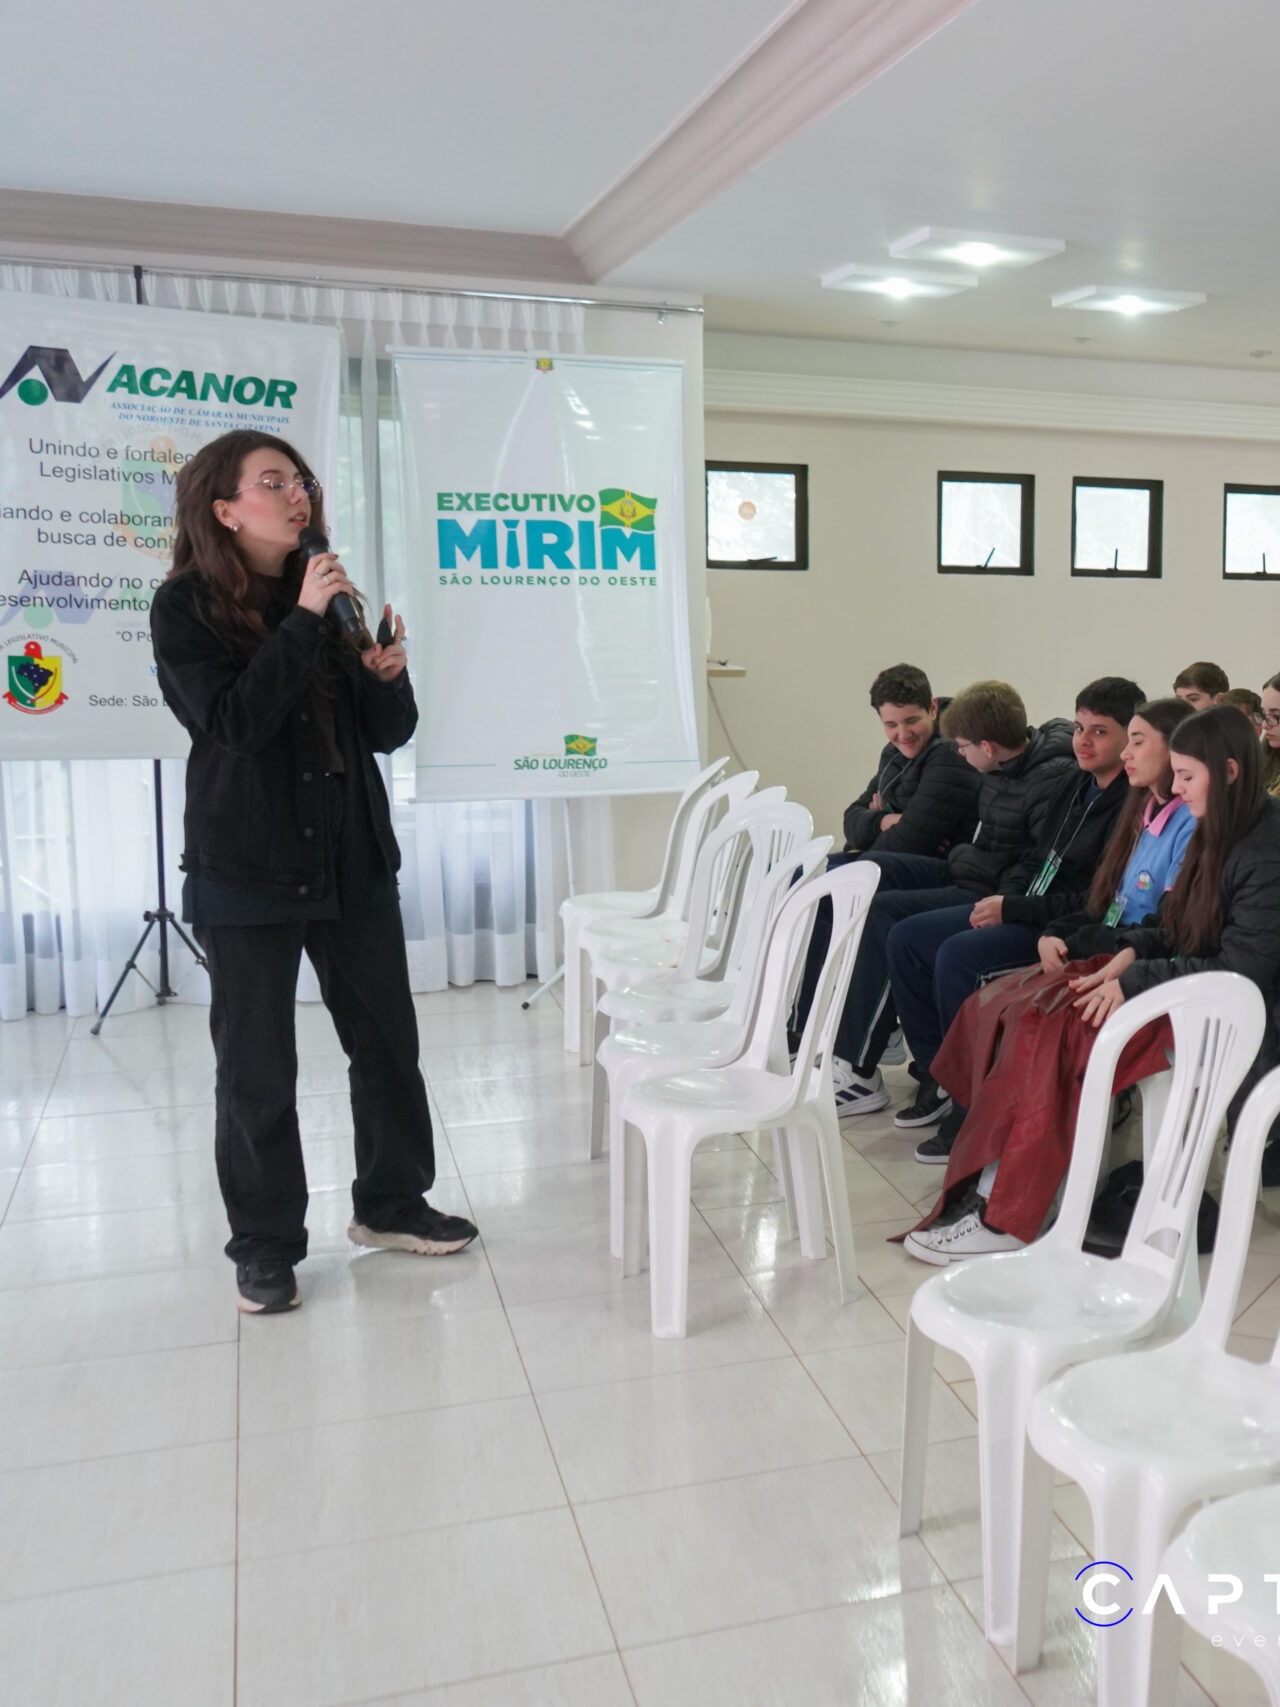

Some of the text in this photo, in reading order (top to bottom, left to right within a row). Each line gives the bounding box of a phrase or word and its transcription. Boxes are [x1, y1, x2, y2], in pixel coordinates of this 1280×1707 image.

[106, 364, 298, 409] ACANOR
[118, 413, 134, 422] DO
[136, 413, 187, 426] NOROESTE
[189, 417, 201, 427] DE
[204, 419, 234, 430] SANTA
[173, 406, 186, 415] DE
[236, 412, 291, 425] MUNICIPAIS
[29, 437, 197, 465] Unindo e fortalec
[40, 461, 155, 484] Legislativos
[436, 491, 597, 514] EXECUTIVO
[60, 509, 73, 523] e
[79, 508, 174, 528] colaboran
[37, 527, 97, 546] busca
[103, 531, 128, 548] de
[18, 569, 114, 590] Ajudando
[119, 575, 143, 590] no
[439, 573, 658, 588] SÃO LOURENÇO DO OESTE
[89, 694, 128, 707] Sede:
[132, 694, 158, 707] São
[513, 756, 608, 772] SÃO LOURENÇO
